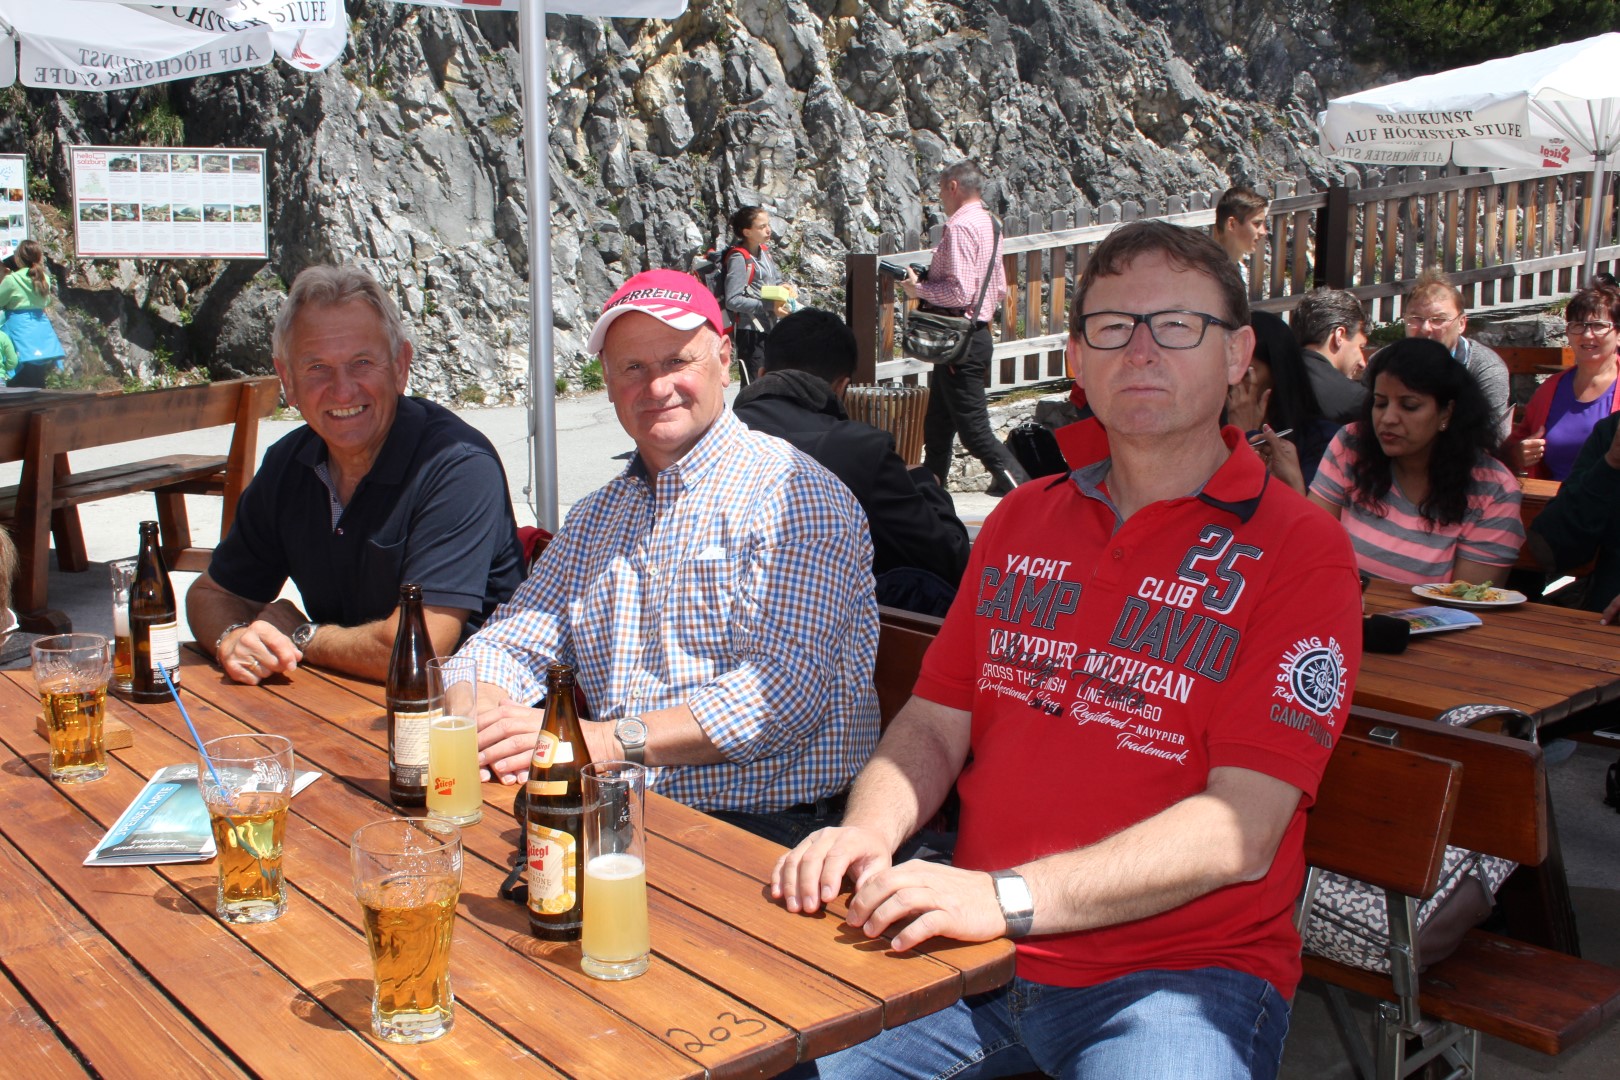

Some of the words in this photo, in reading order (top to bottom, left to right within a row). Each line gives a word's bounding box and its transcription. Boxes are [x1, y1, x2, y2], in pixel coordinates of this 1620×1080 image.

[268, 1, 326, 23] STUFE
[1344, 129, 1377, 144] AUF
[1383, 126, 1472, 140] HÖCHSTER
[1473, 123, 1522, 138] STUFE
[1376, 110, 1473, 125] BRAUKUNST
[77, 158, 107, 167] salzburg
[1005, 553, 1072, 581] YACHT
[1137, 576, 1198, 608] CLUB
[1175, 523, 1264, 616] 25
[975, 566, 1082, 630] CAMP
[1108, 595, 1241, 683] DAVID
[982, 662, 1014, 683] CROSS
[1076, 682, 1105, 704] LINE
[1083, 647, 1196, 704] MICHIGAN
[1276, 636, 1323, 683] SAILING
[1328, 636, 1348, 710] REGATTA
[1069, 700, 1131, 730] Registered
[1116, 732, 1190, 765] Trademark
[434, 777, 456, 790] Stiegl
[665, 1011, 767, 1053] 203
